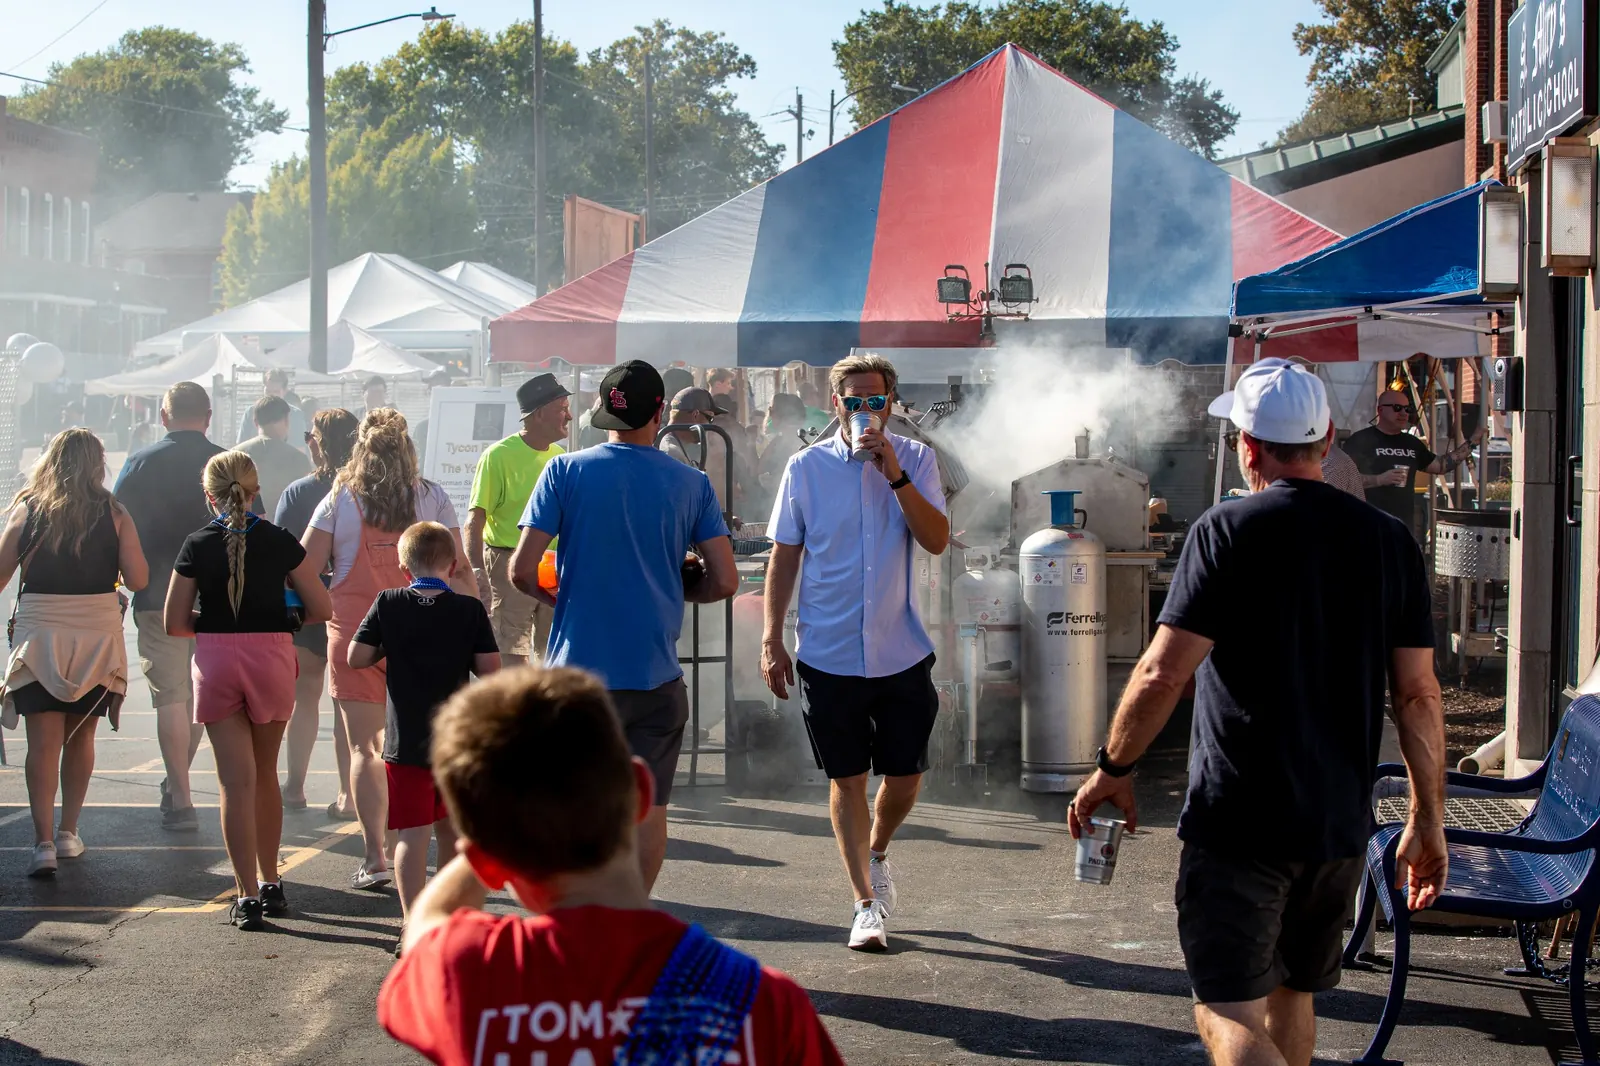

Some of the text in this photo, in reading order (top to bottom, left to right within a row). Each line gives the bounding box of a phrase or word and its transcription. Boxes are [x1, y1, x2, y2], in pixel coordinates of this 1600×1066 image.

[1376, 448, 1416, 458] ROGUE
[441, 463, 462, 474] The
[502, 1000, 605, 1044] TOM
